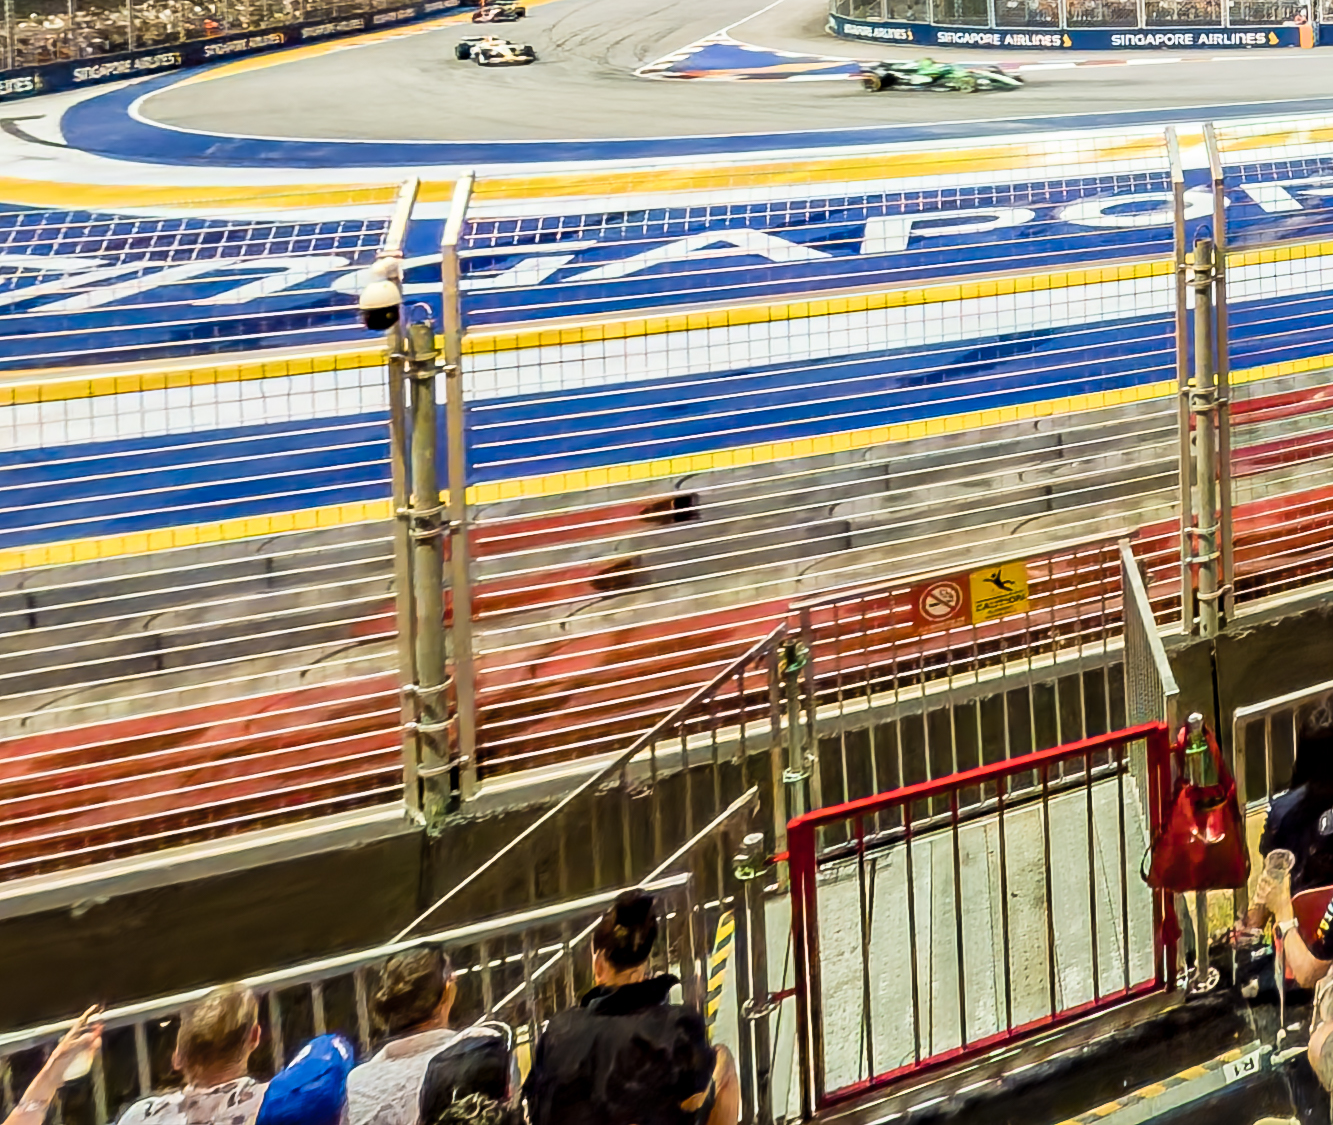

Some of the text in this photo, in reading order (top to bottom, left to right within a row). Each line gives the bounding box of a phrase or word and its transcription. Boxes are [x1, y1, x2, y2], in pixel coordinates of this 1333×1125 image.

[937, 31, 1061, 47] SINGAPORE AIRLINES
[1111, 32, 1266, 46] SINGAPORE AIRLINES
